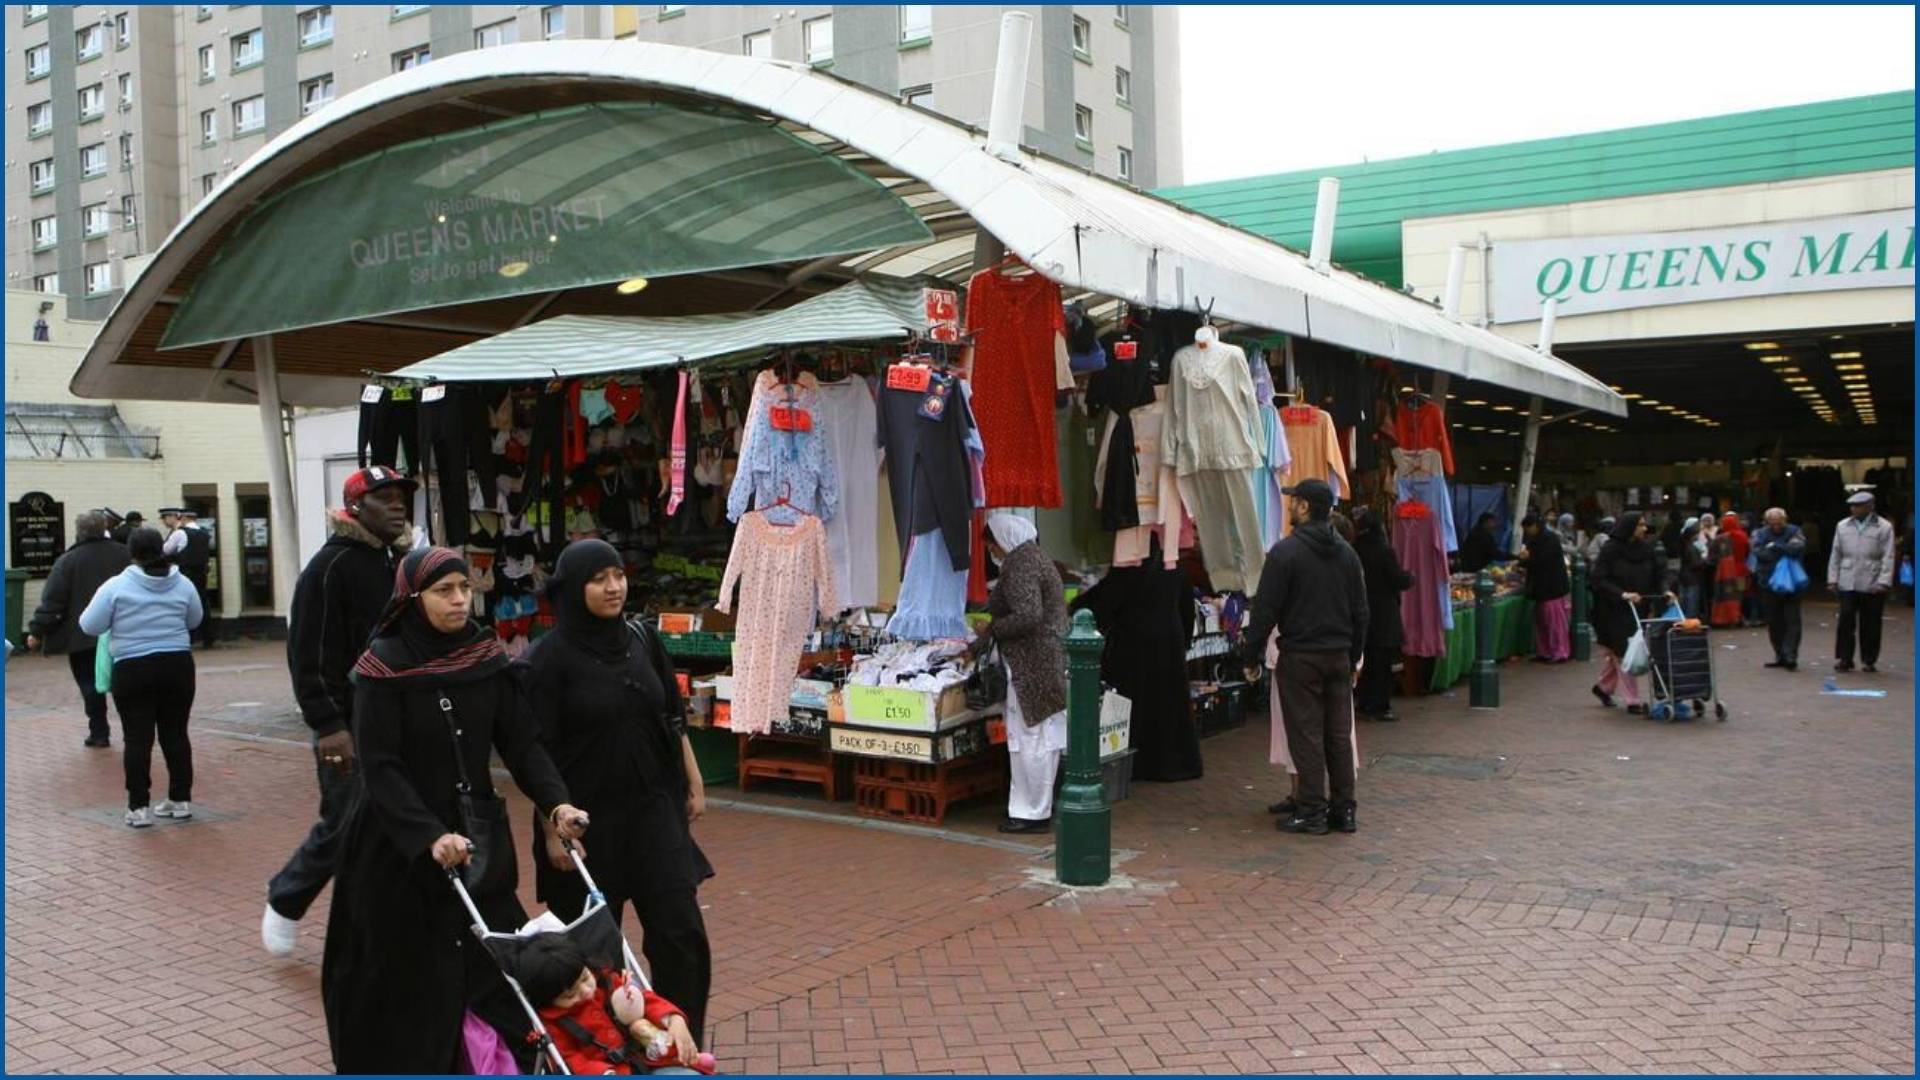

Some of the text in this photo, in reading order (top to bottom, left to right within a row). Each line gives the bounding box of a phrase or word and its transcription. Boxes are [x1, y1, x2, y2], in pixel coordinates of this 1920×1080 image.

[423, 188, 521, 217] Welcome to
[350, 194, 609, 269] QUEENS MARKET
[409, 265, 441, 285] Set
[443, 260, 460, 280] to
[466, 254, 496, 281] get
[1536, 240, 1772, 304] QUEENS
[839, 735, 862, 748] PACK
